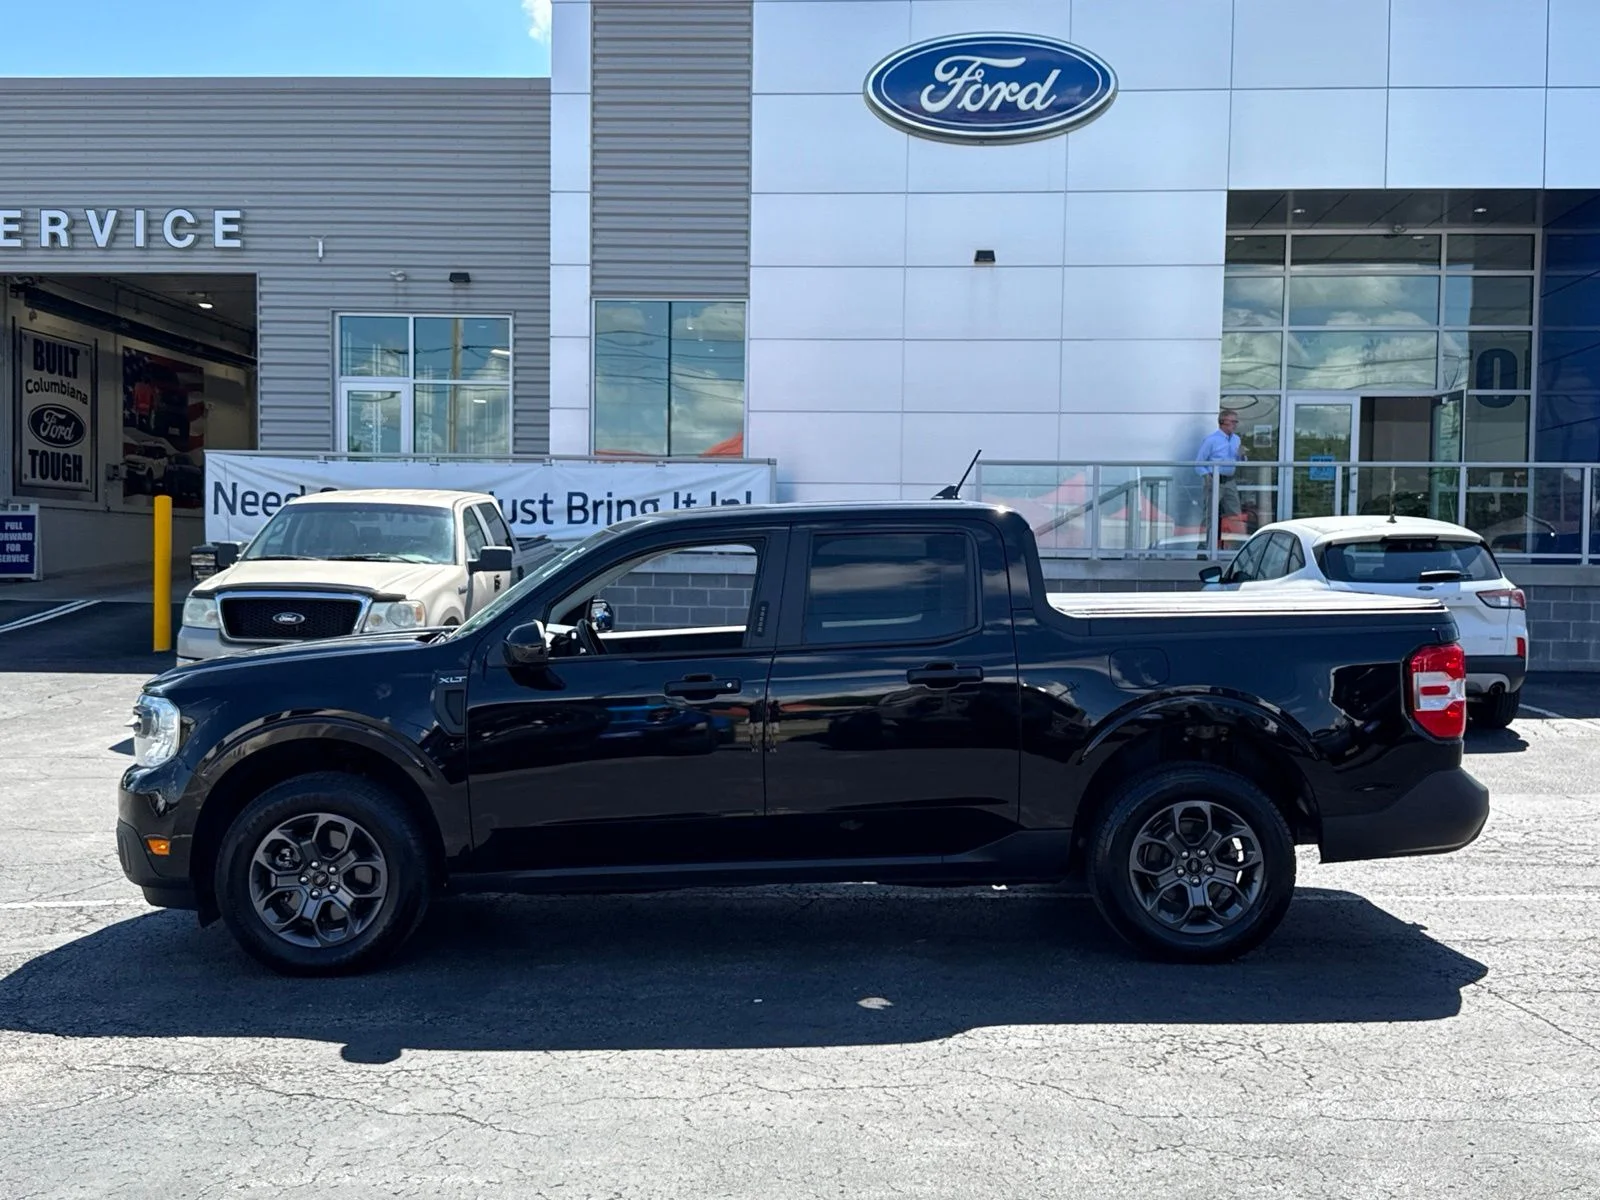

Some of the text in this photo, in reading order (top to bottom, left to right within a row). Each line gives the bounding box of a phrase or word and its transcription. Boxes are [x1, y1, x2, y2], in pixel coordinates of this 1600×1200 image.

[920, 55, 1062, 113] Ford
[0, 208, 242, 248] ERVICE
[33, 338, 80, 379] BUILT
[25, 377, 89, 405] Columbiana
[39, 410, 76, 441] Ford
[28, 449, 83, 483] TOUGH
[489, 491, 554, 525] ust
[5, 521, 23, 530] PULL
[439, 676, 467, 684] XLT
